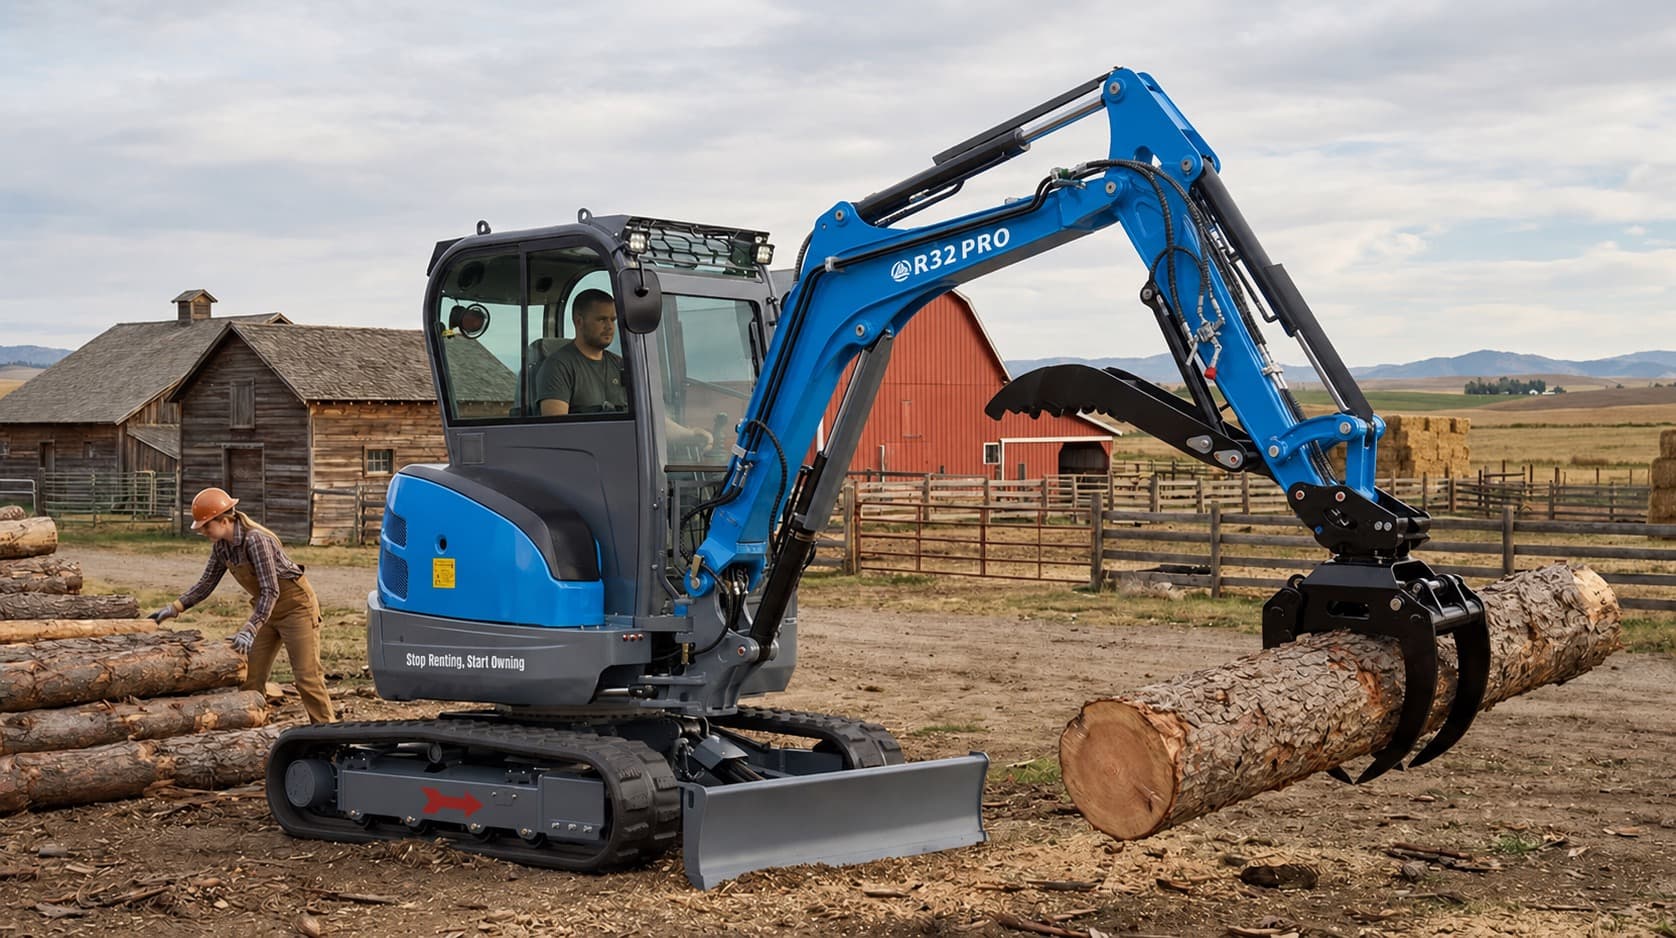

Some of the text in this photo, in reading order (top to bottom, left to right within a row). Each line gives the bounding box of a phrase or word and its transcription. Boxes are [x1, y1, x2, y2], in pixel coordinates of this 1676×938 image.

[914, 227, 1010, 275] R32 PRO
[406, 652, 525, 671] Stop Renting, Start Owning
